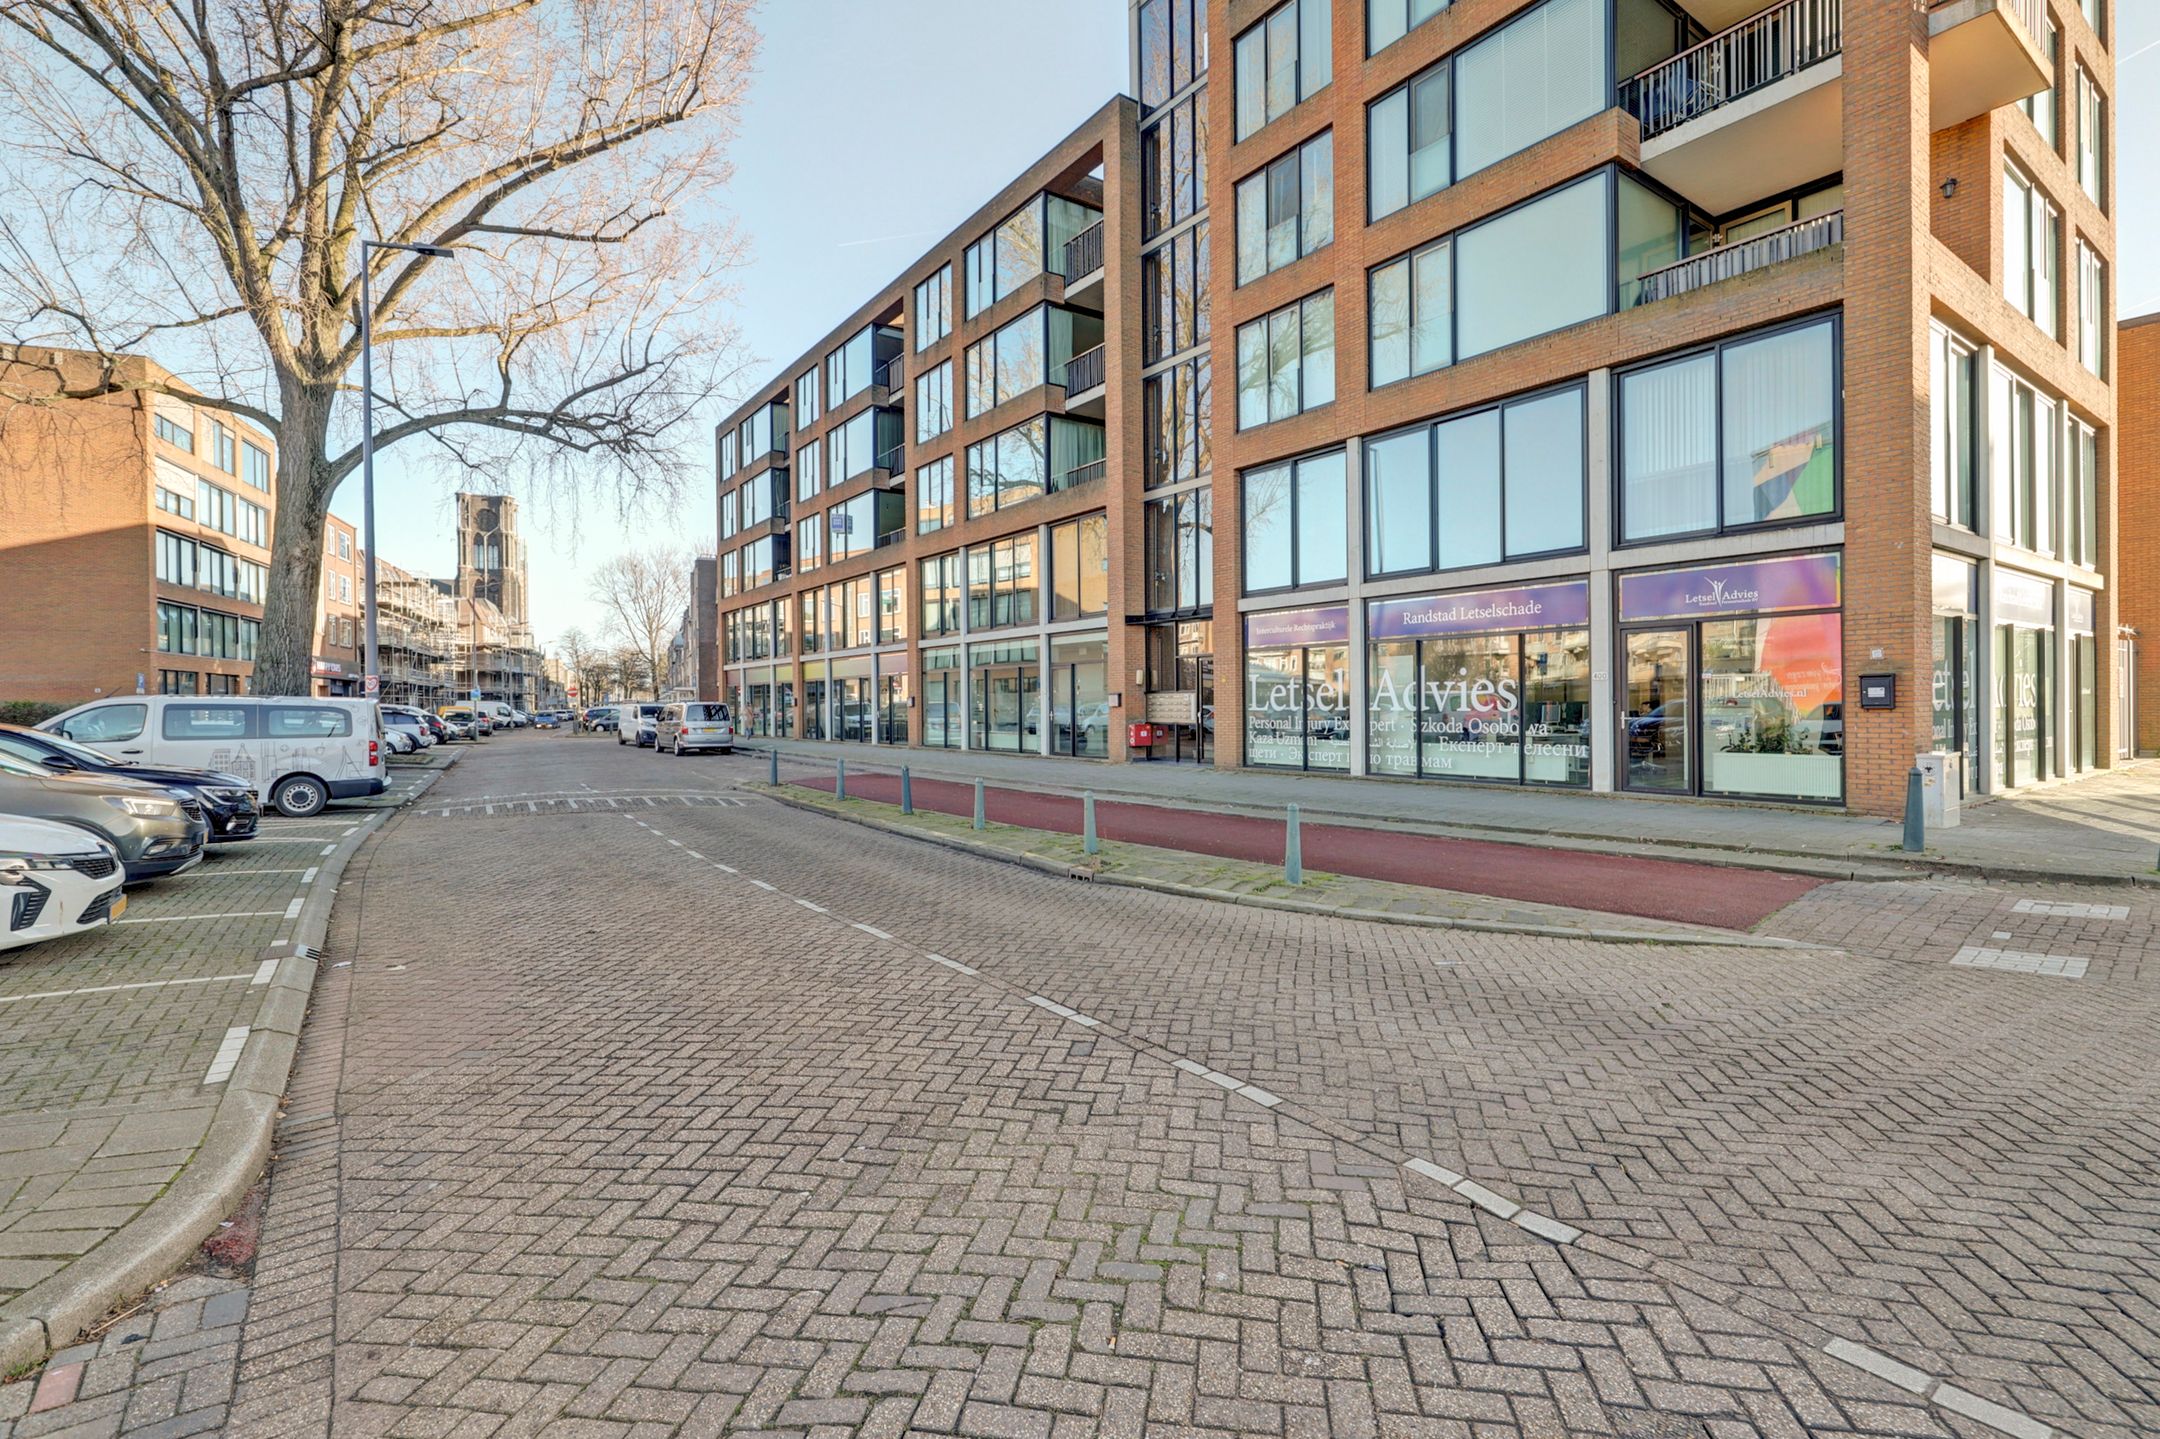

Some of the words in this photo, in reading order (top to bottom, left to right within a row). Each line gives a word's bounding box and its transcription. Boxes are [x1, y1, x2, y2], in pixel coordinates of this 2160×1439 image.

[1685, 592, 1716, 603] Letsel
[1722, 589, 1759, 600] Advies
[1403, 608, 1457, 625] Randstad
[1460, 600, 1543, 620] Letselschade
[1248, 668, 1350, 712] Letsel
[1369, 665, 1518, 712] Advies
[1249, 716, 1292, 729] Personal
[1249, 731, 1274, 744] Kaza
